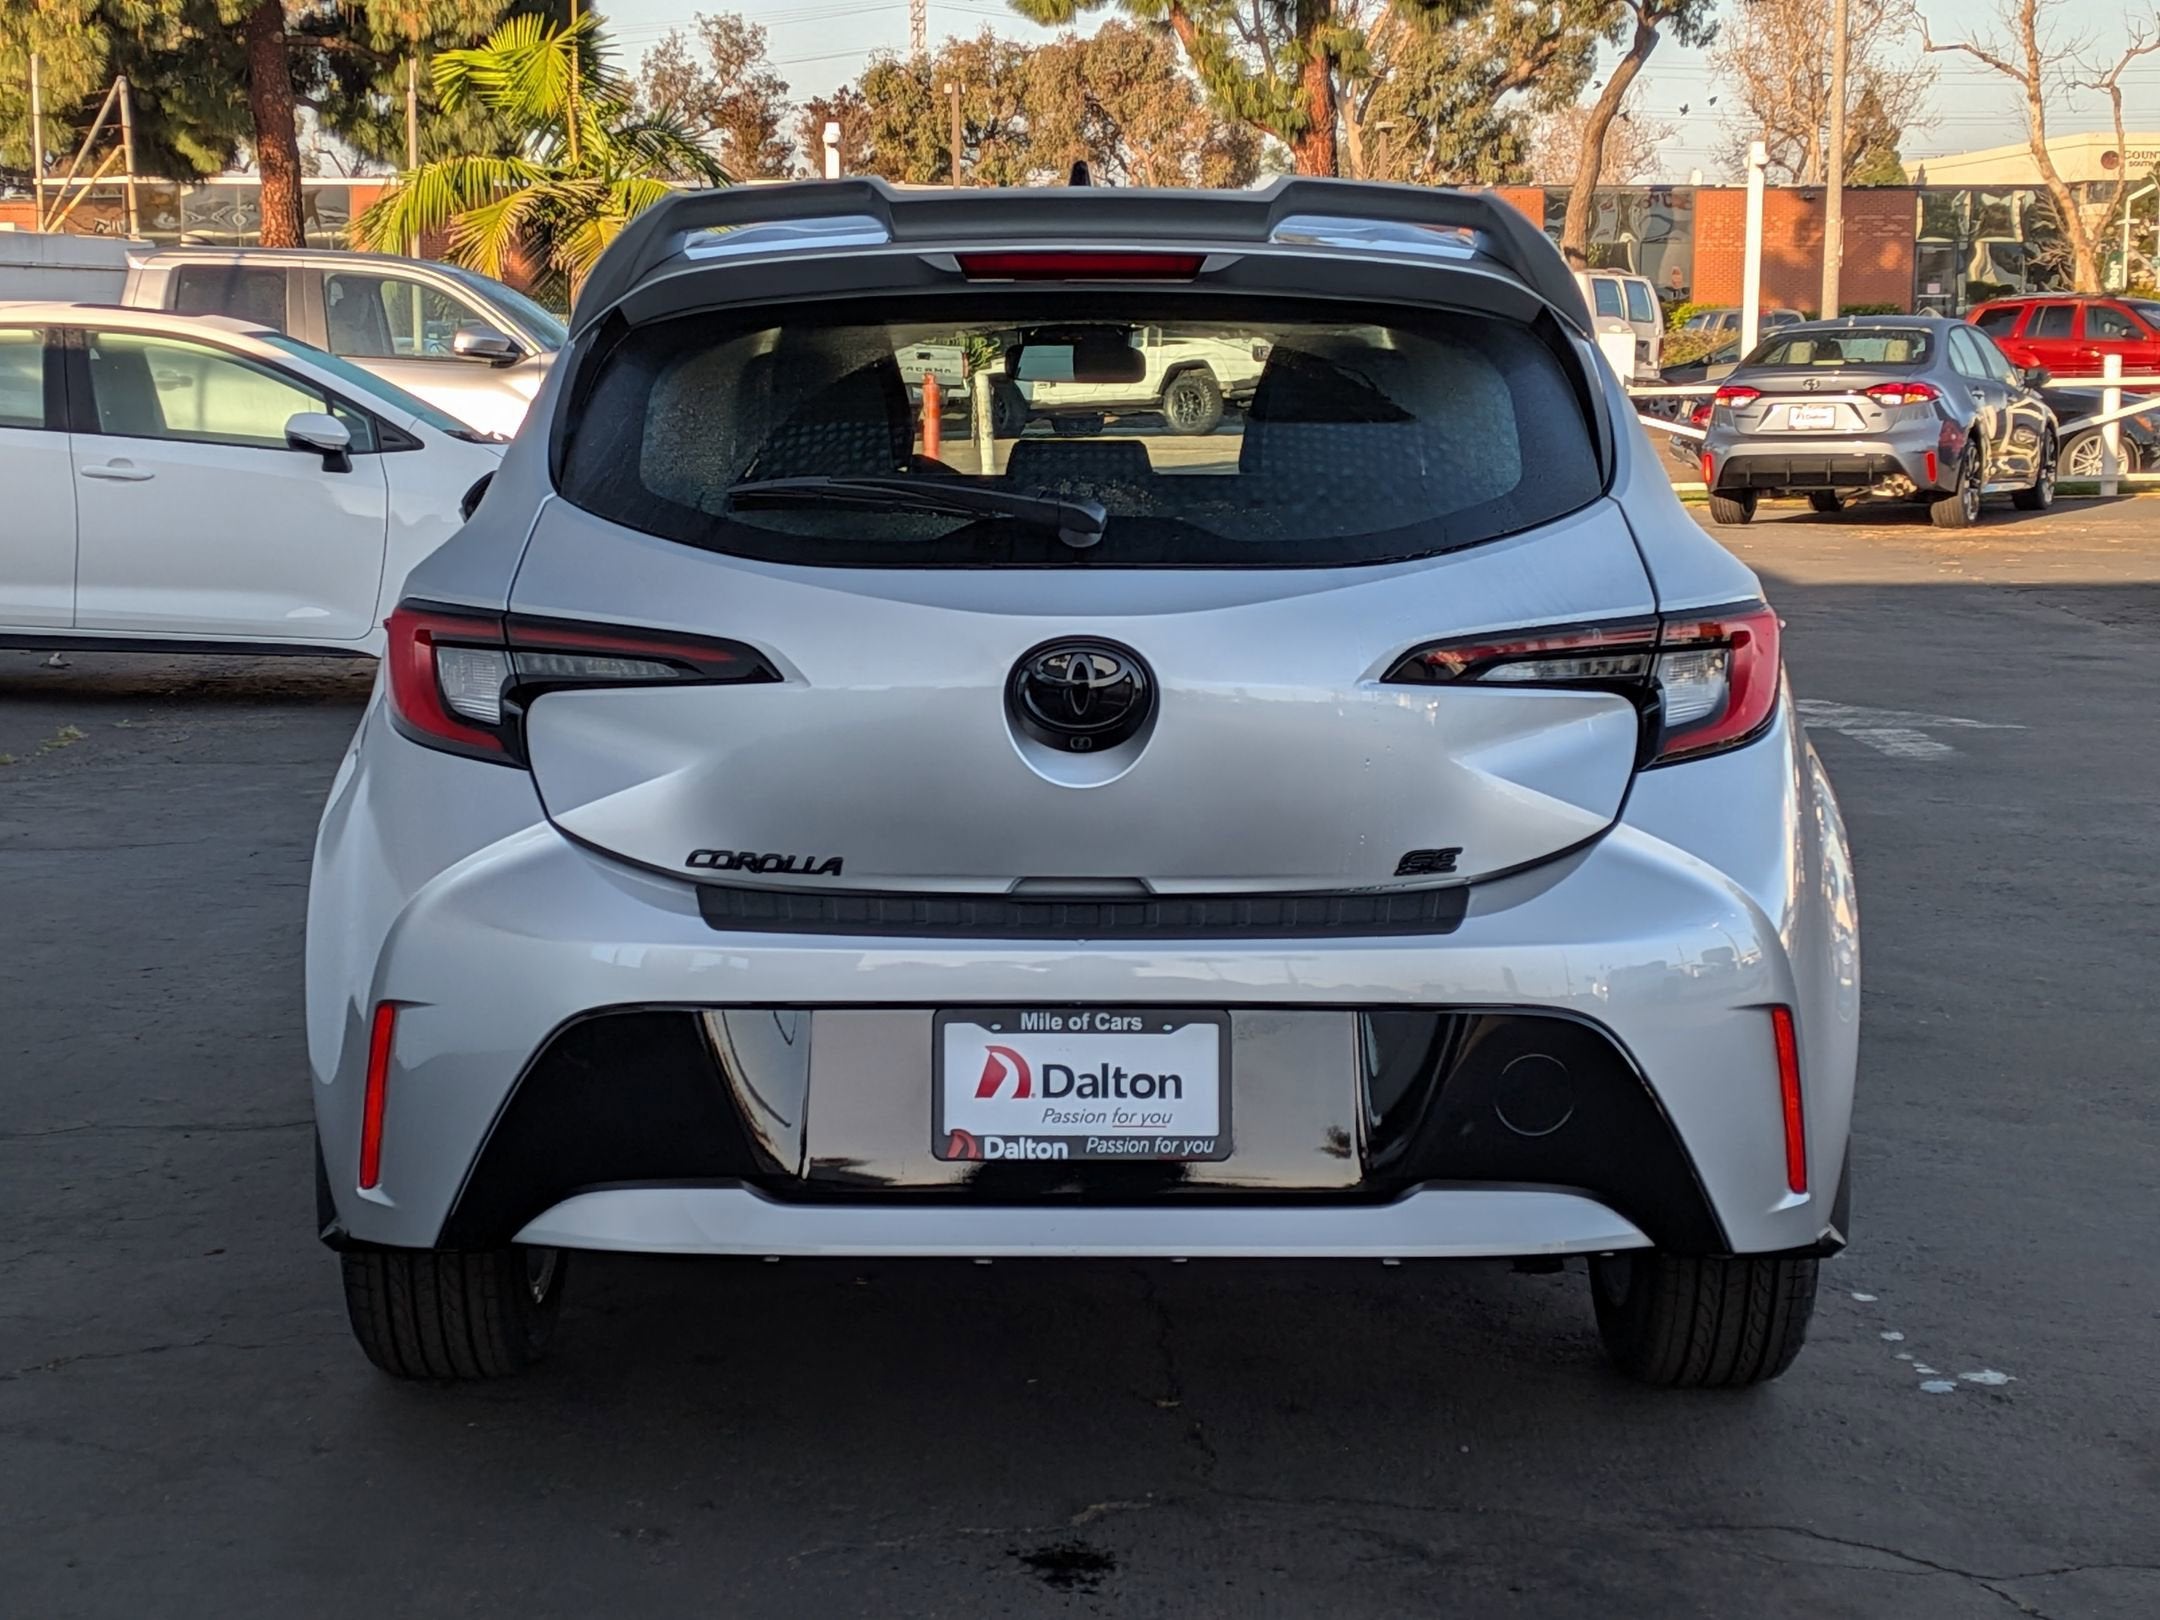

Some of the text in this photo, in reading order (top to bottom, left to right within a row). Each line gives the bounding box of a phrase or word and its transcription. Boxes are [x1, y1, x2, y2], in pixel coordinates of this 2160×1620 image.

[685, 849, 844, 876] COROLLA
[1020, 1012, 1143, 1031] Mile of Cars
[1041, 1062, 1183, 1099] Dalton
[1041, 1108, 1173, 1126] Passion for you
[983, 1136, 1215, 1160] Dalton Passion for you
